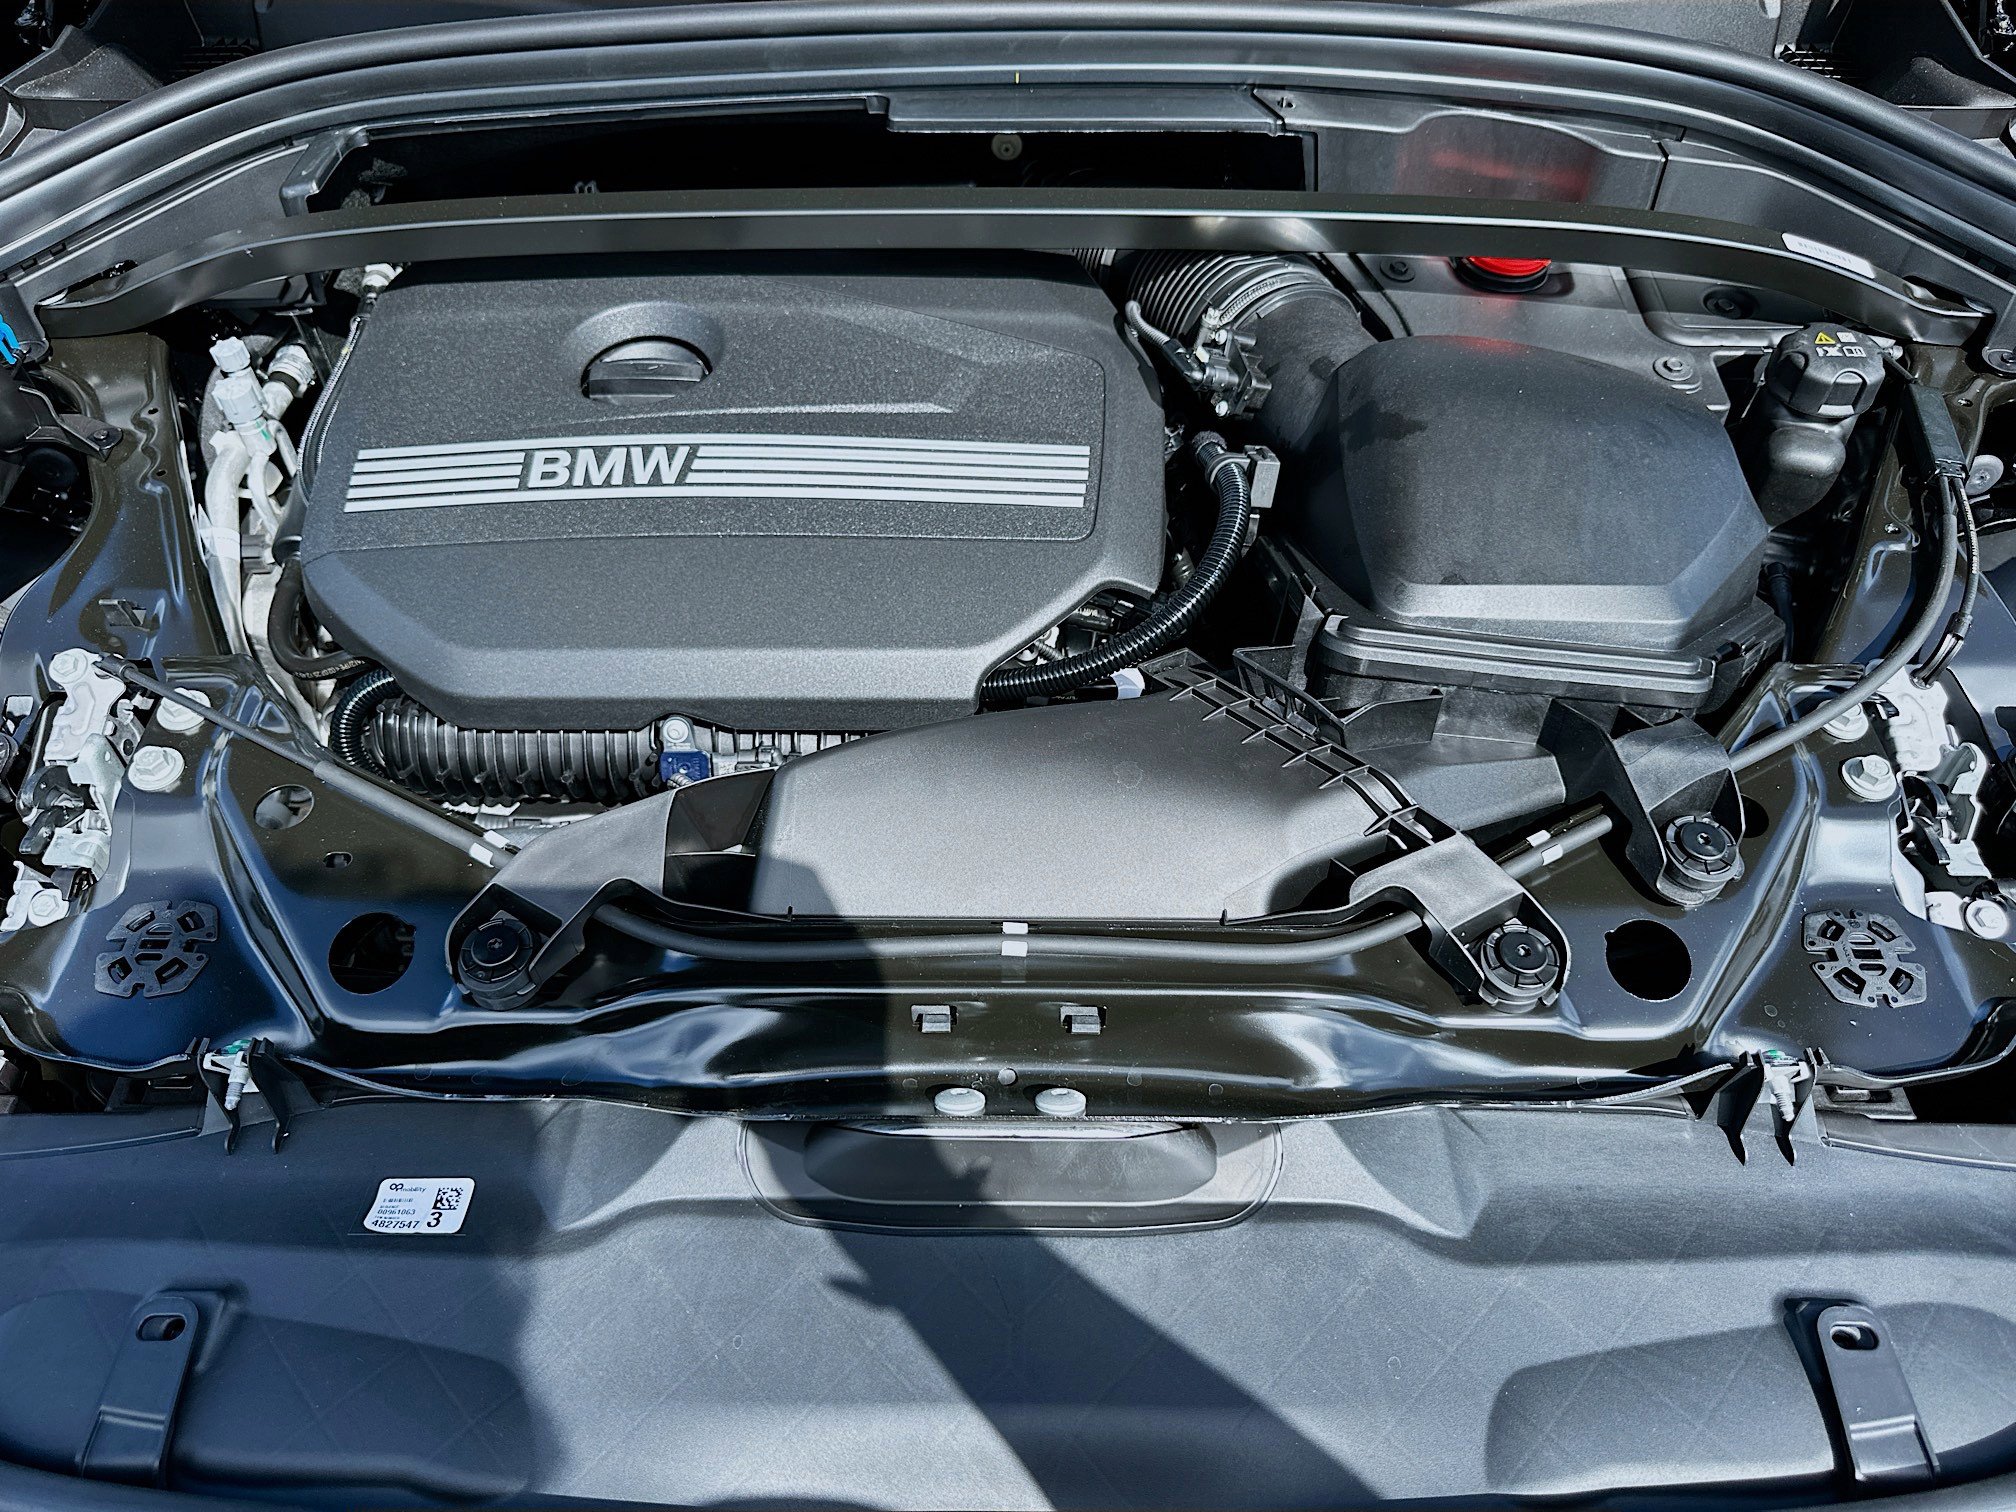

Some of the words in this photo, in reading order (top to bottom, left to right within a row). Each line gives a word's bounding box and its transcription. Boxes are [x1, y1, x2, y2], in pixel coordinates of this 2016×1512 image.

[527, 445, 691, 488] BMW
[372, 1220, 420, 1228] 4827547
[427, 1211, 442, 1227] 3
